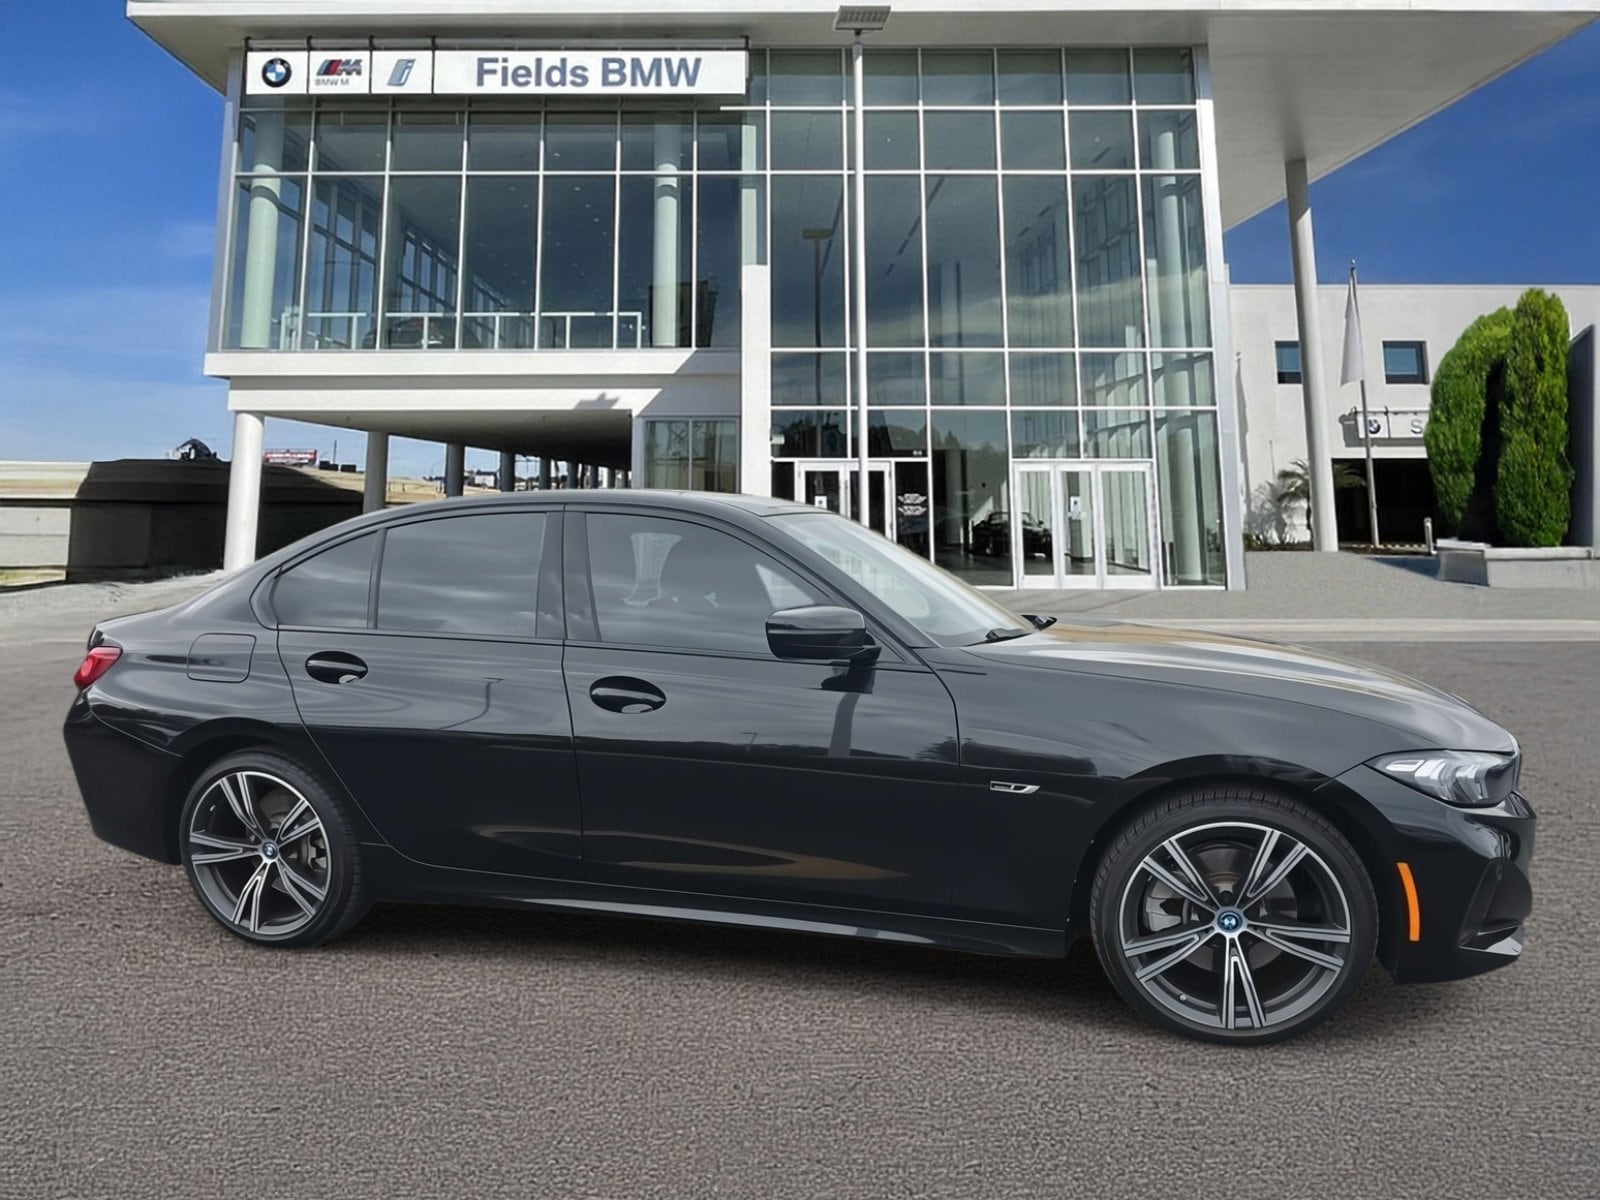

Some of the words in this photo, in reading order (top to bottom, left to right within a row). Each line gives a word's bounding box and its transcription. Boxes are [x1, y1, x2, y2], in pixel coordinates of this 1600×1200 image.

[477, 57, 588, 87] Fields
[601, 57, 702, 87] BMW
[315, 78, 338, 86] BMW
